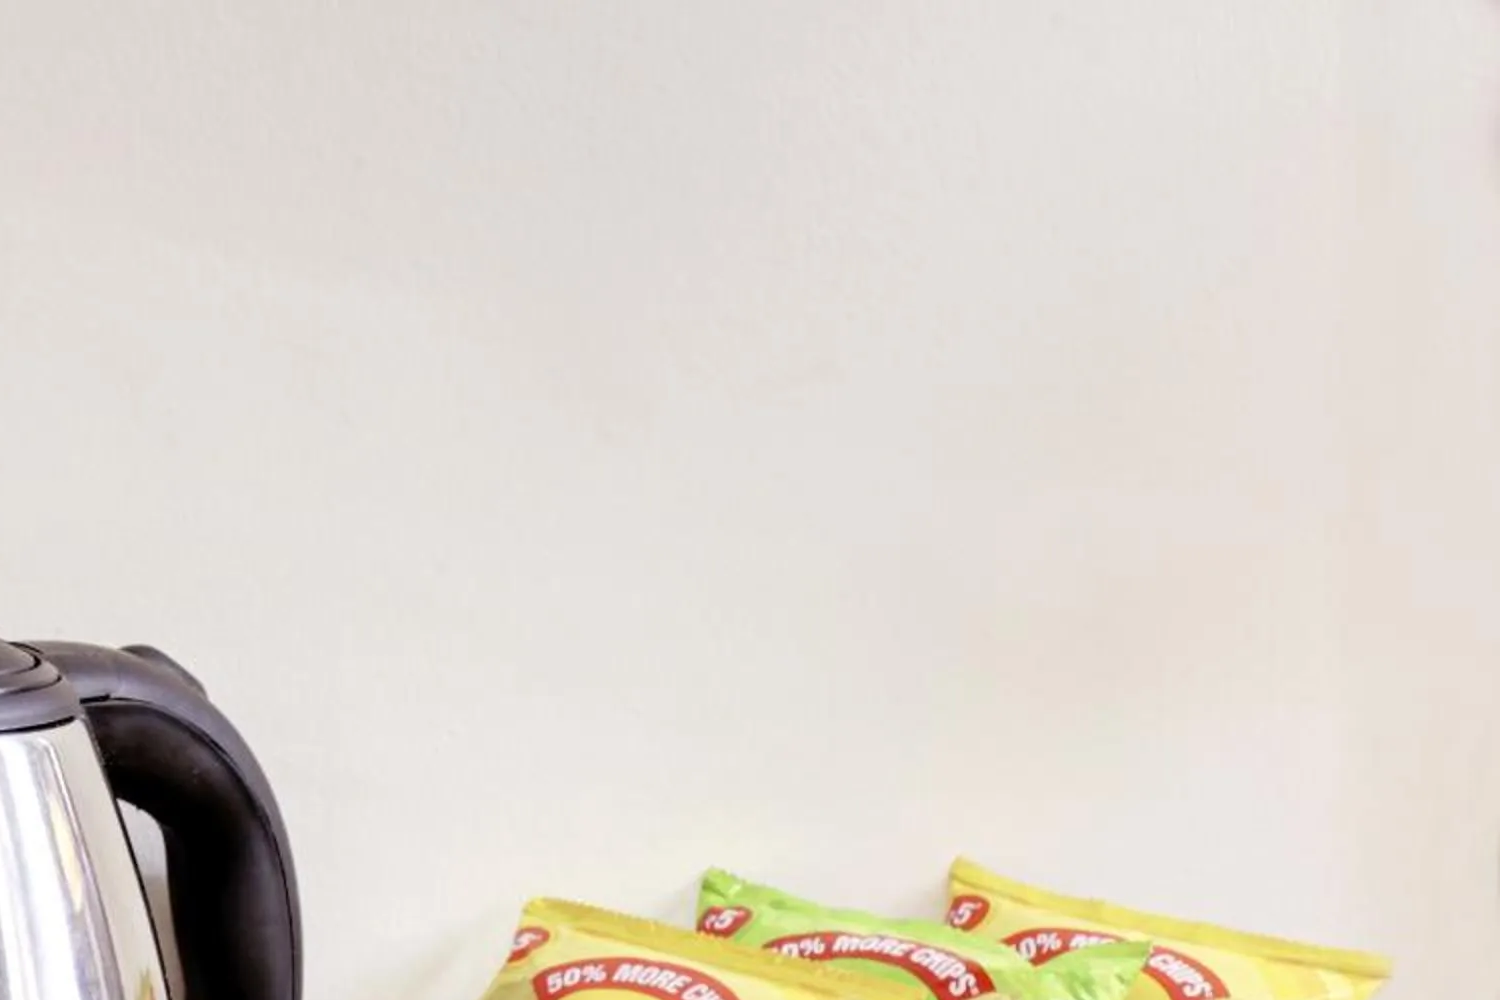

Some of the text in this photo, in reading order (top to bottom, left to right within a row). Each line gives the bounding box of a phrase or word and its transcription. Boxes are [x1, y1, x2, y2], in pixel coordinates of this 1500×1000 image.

[1016, 931, 1063, 959] 0%
[547, 963, 607, 993] 50%
[612, 962, 693, 994] MORE
[781, 934, 979, 997] 0% MORE CHIPS
